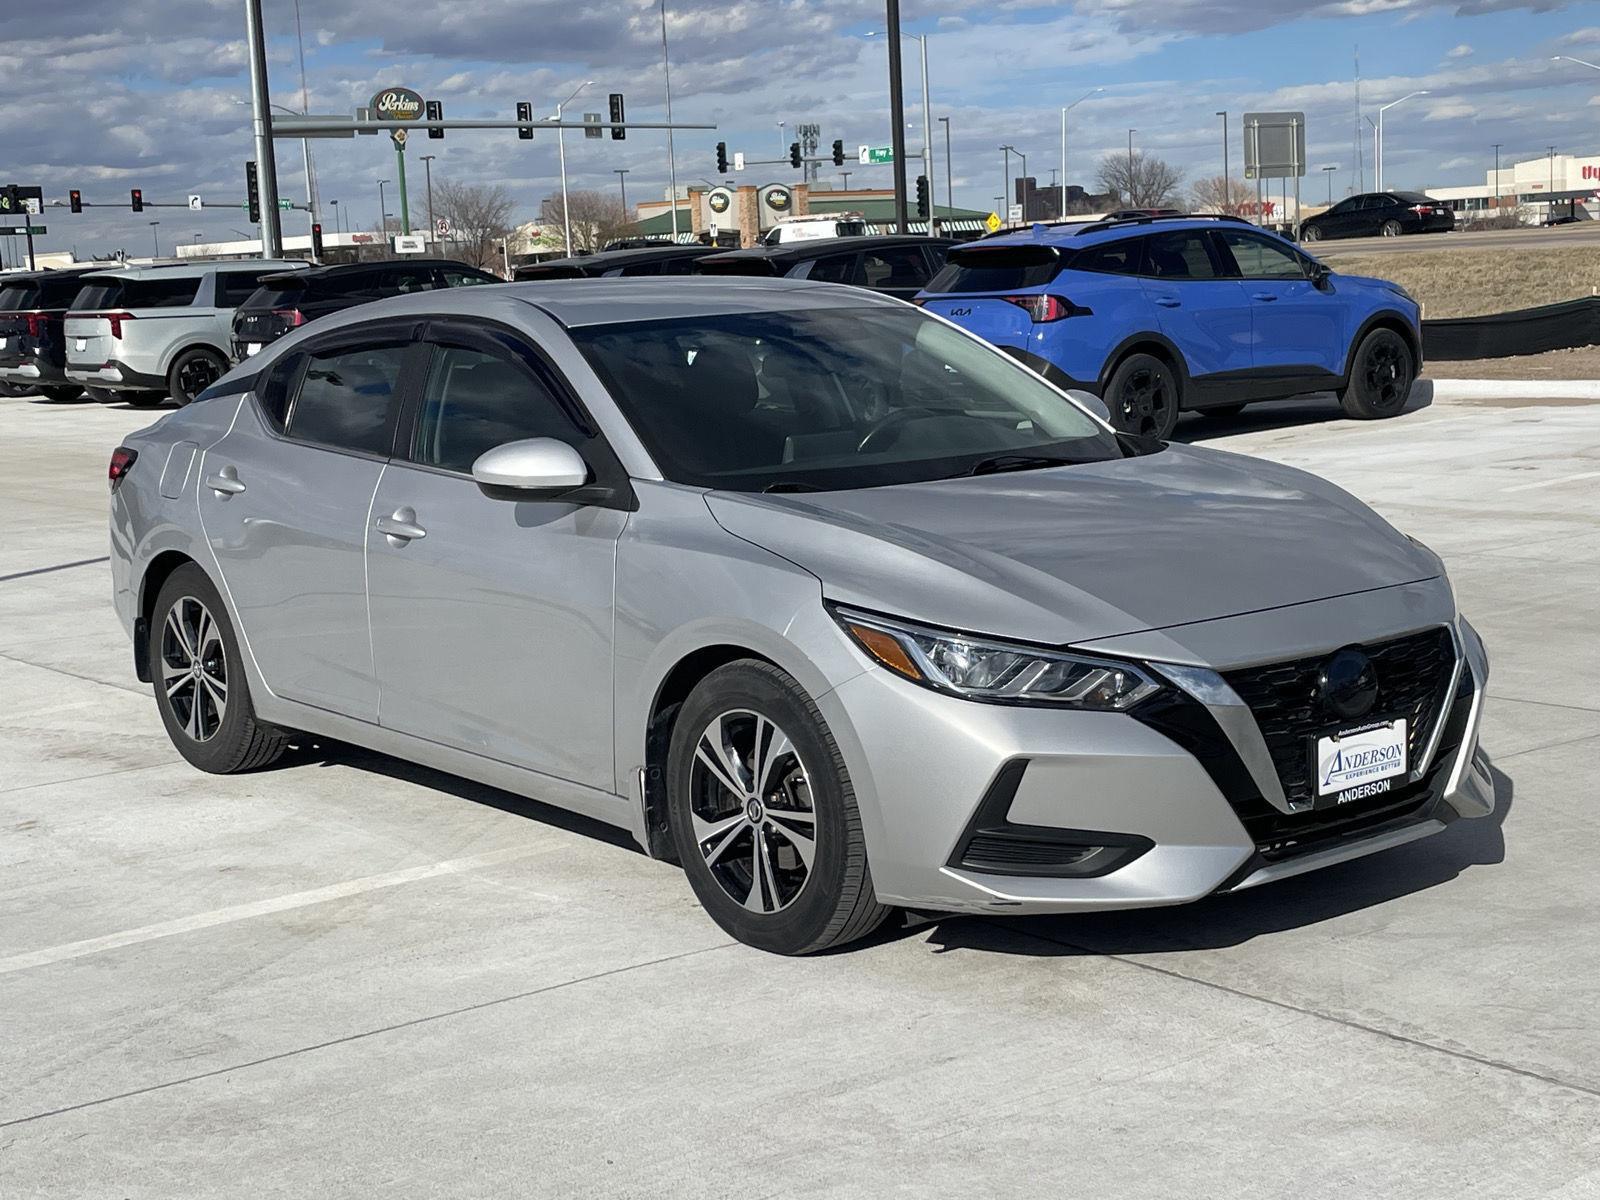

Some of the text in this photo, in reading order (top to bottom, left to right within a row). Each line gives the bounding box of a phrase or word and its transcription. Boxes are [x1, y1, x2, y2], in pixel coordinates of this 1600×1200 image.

[378, 92, 419, 111] Perkins
[1322, 743, 1404, 787] ANDERSON
[1345, 761, 1401, 780] EXPERIENCE BETTER
[1337, 779, 1391, 804] ANDERSON
